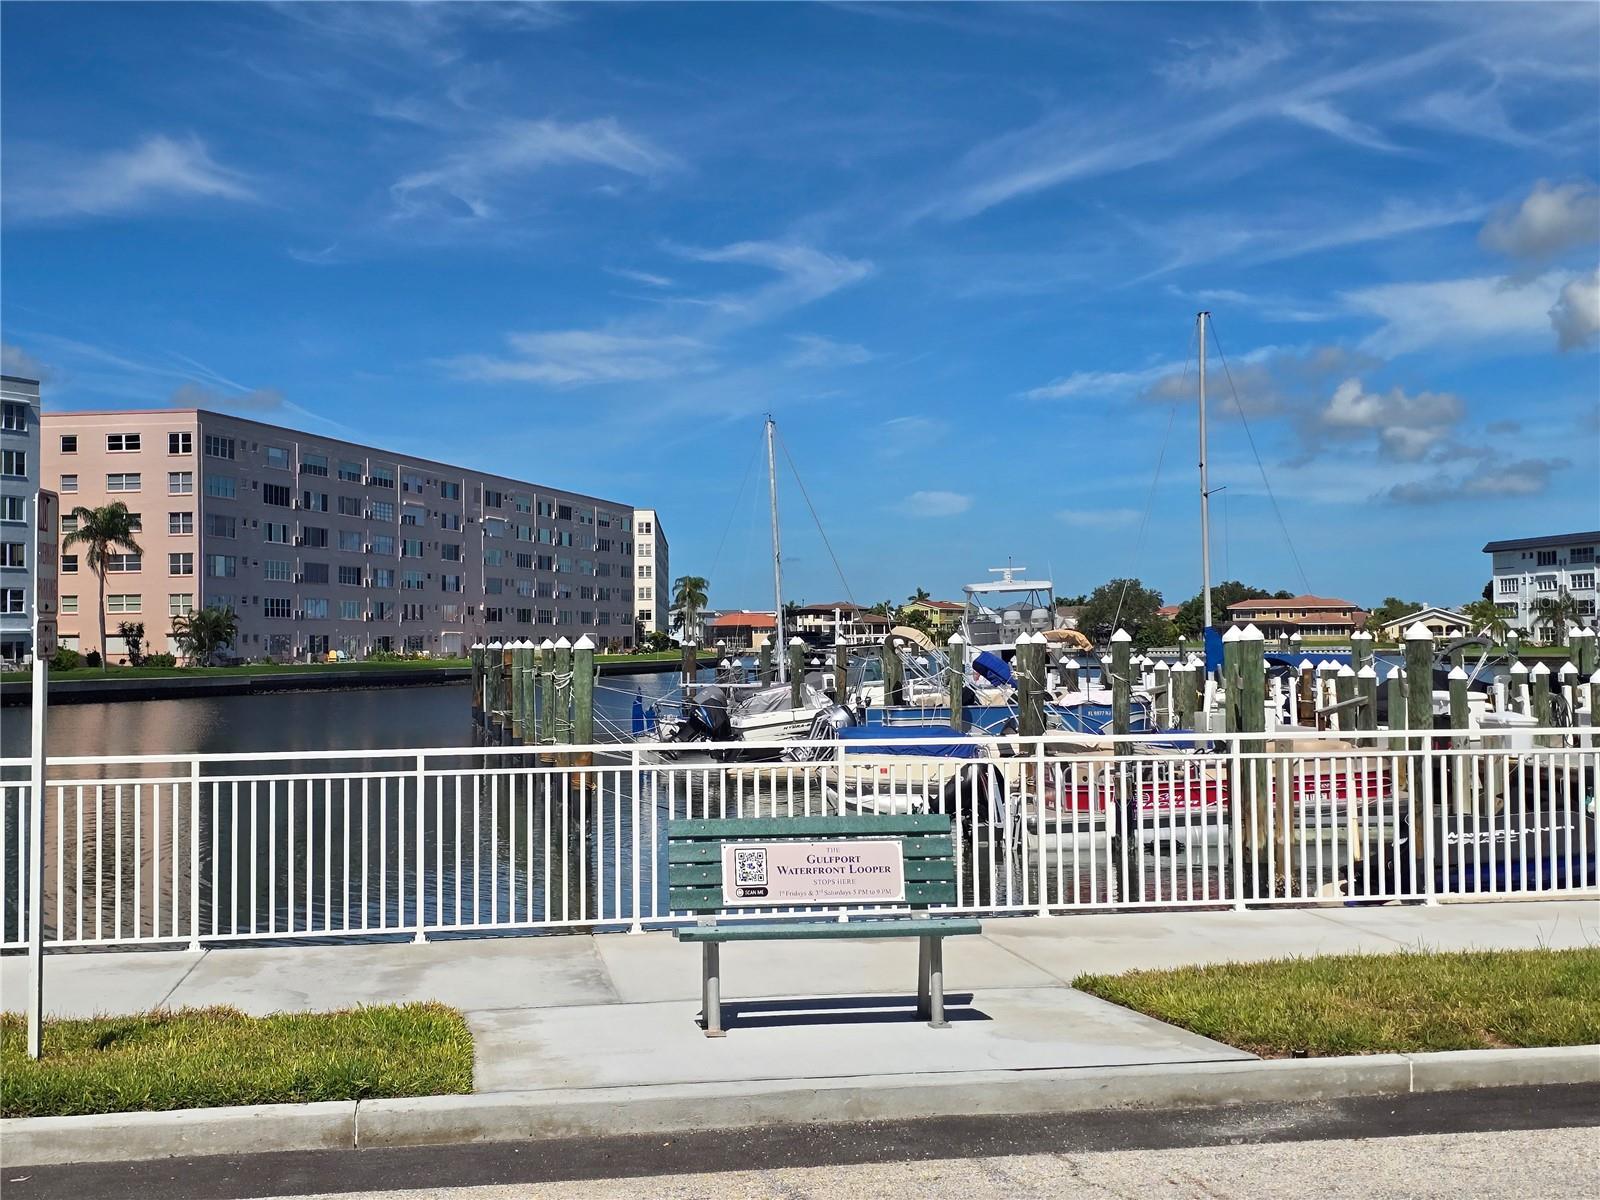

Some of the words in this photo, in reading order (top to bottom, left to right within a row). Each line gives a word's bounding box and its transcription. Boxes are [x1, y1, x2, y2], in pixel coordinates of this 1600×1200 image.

[806, 854, 861, 864] GULFPORT
[776, 865, 846, 875] WATERFRONT
[849, 864, 891, 874] LOOPER
[744, 888, 757, 896] SCAN
[785, 889, 807, 897] Fridays
[824, 888, 852, 896] Saturdays
